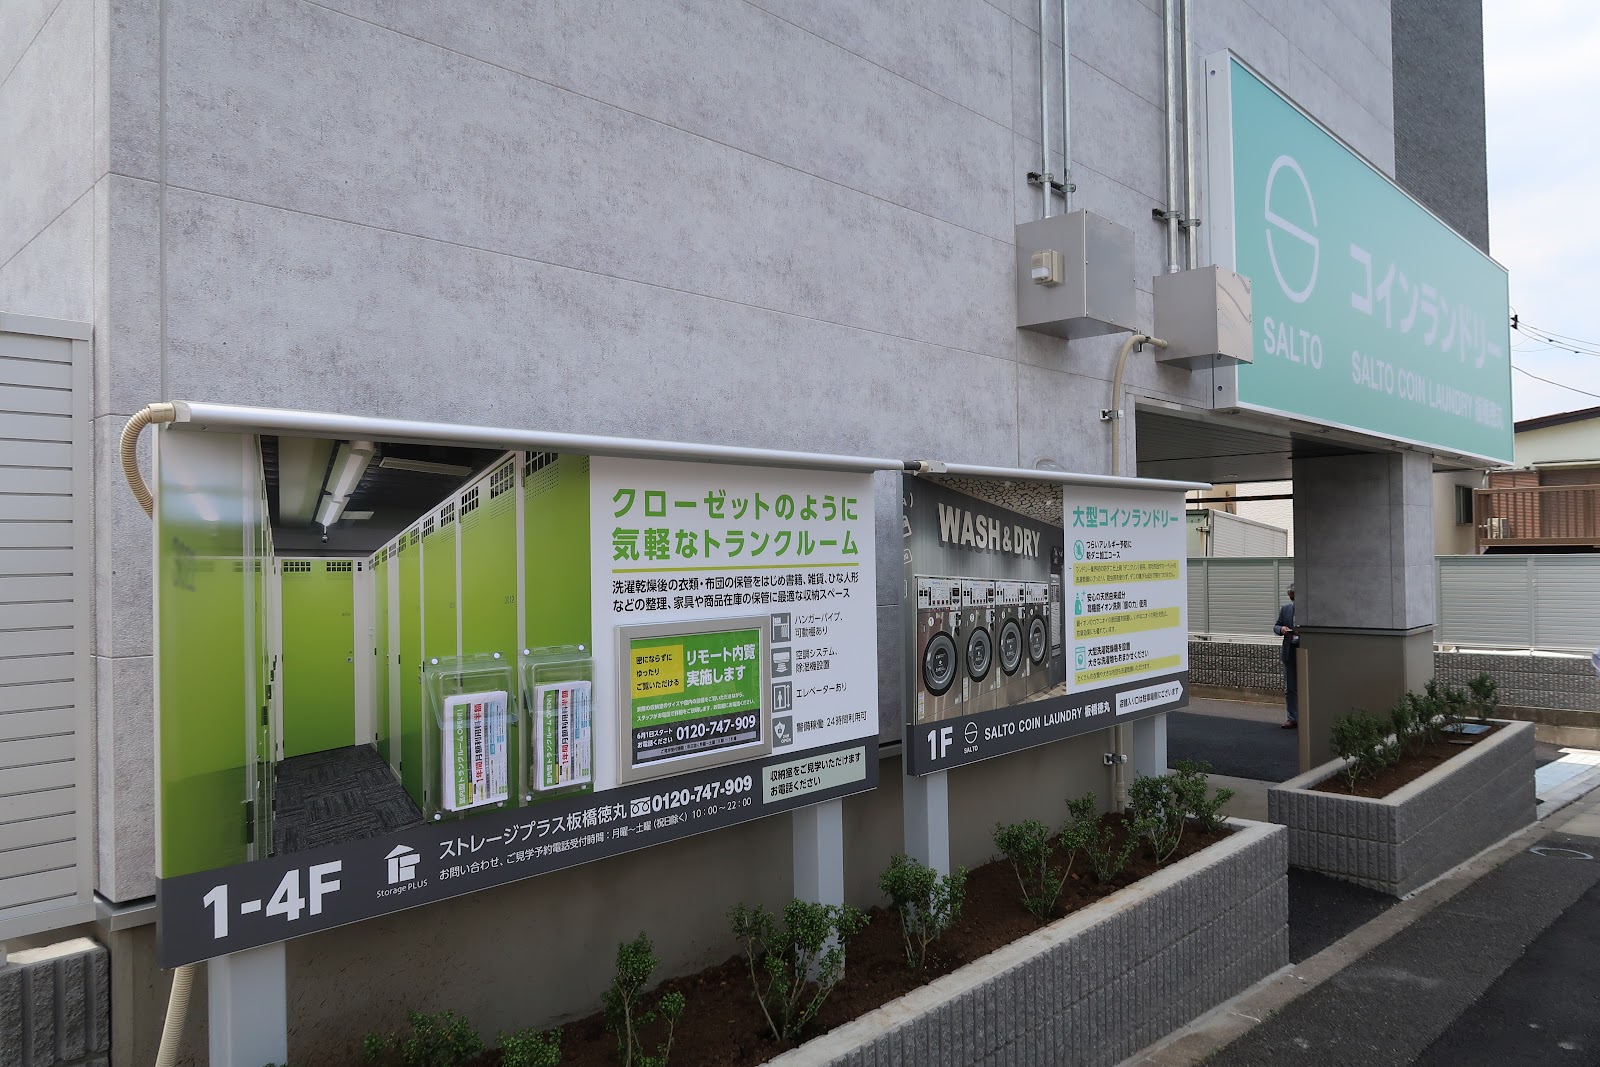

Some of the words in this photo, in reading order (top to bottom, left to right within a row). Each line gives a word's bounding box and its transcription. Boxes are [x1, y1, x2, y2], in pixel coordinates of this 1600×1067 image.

[1350, 242, 1503, 369] コインランドリー
[1263, 315, 1323, 370] SALTO
[1352, 350, 1394, 395] SALTO
[1398, 368, 1427, 405] COIN
[1429, 382, 1473, 421] LAUNDRY
[612, 488, 858, 521] クローゼットのように
[1072, 505, 1179, 528] 大型コインランドリー
[938, 502, 1000, 550] WASH
[1002, 525, 1013, 552] &
[1014, 525, 1041, 558] DRY
[612, 527, 859, 561] 気軽なトランクルーム
[612, 571, 859, 594] 洗濯乾燥後の衣類・布団の保管をはじめ書籍、雑貨、ひな人形
[613, 588, 850, 612] などの整理、家具や商品在庫の保管に最適な収納スペース
[636, 653, 673, 665] 密にならずに
[686, 643, 756, 666] リモート内覧
[636, 668, 660, 677] ゆったり
[686, 665, 746, 688] 実施します
[636, 678, 680, 691] ご覧いただける
[796, 682, 847, 698] エレベーターあり
[636, 727, 673, 740] 6月1日スタート
[676, 714, 756, 741] 0120-747-909
[984, 721, 1016, 741] SALTO
[1018, 715, 1041, 733] COIN
[1043, 707, 1083, 728] LAUNDRY
[636, 736, 674, 749] お電話ください
[927, 726, 954, 761] 1F
[963, 744, 979, 754] SALTO
[770, 752, 861, 782] 収納室をご見学いただけます
[770, 776, 821, 797] お電話ください
[439, 802, 627, 860] ストレージプラス板橋徳丸
[652, 774, 753, 812] 0120-747-909
[203, 859, 342, 939] 1-4F
[376, 884, 407, 899] Storage
[407, 878, 428, 891] PLUS
